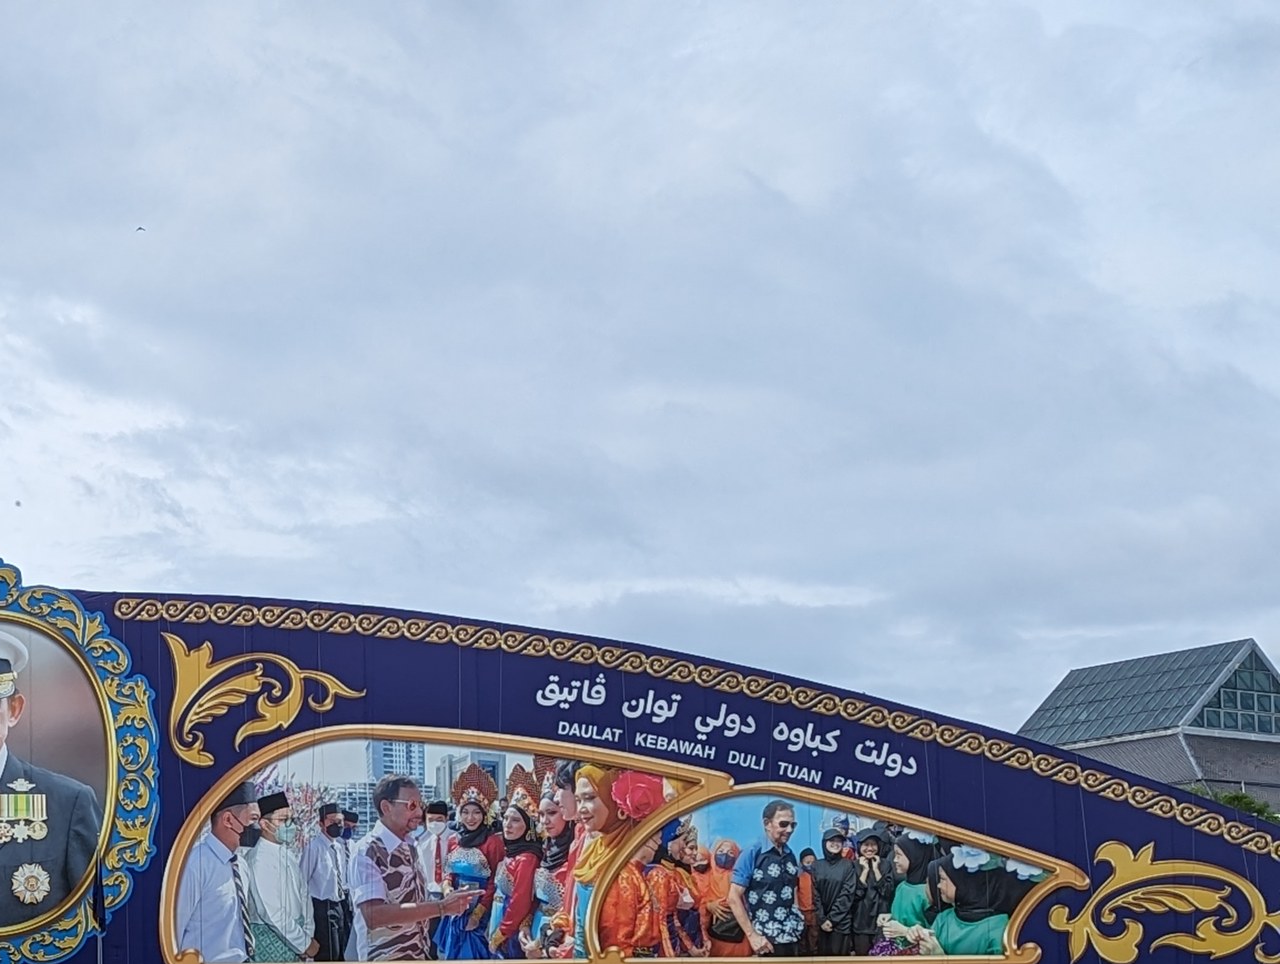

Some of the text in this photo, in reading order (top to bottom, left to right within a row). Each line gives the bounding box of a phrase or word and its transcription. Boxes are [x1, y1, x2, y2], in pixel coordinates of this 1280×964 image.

[557, 721, 881, 801] DAULAT KEBAWAH DULI TUAN PATIK
